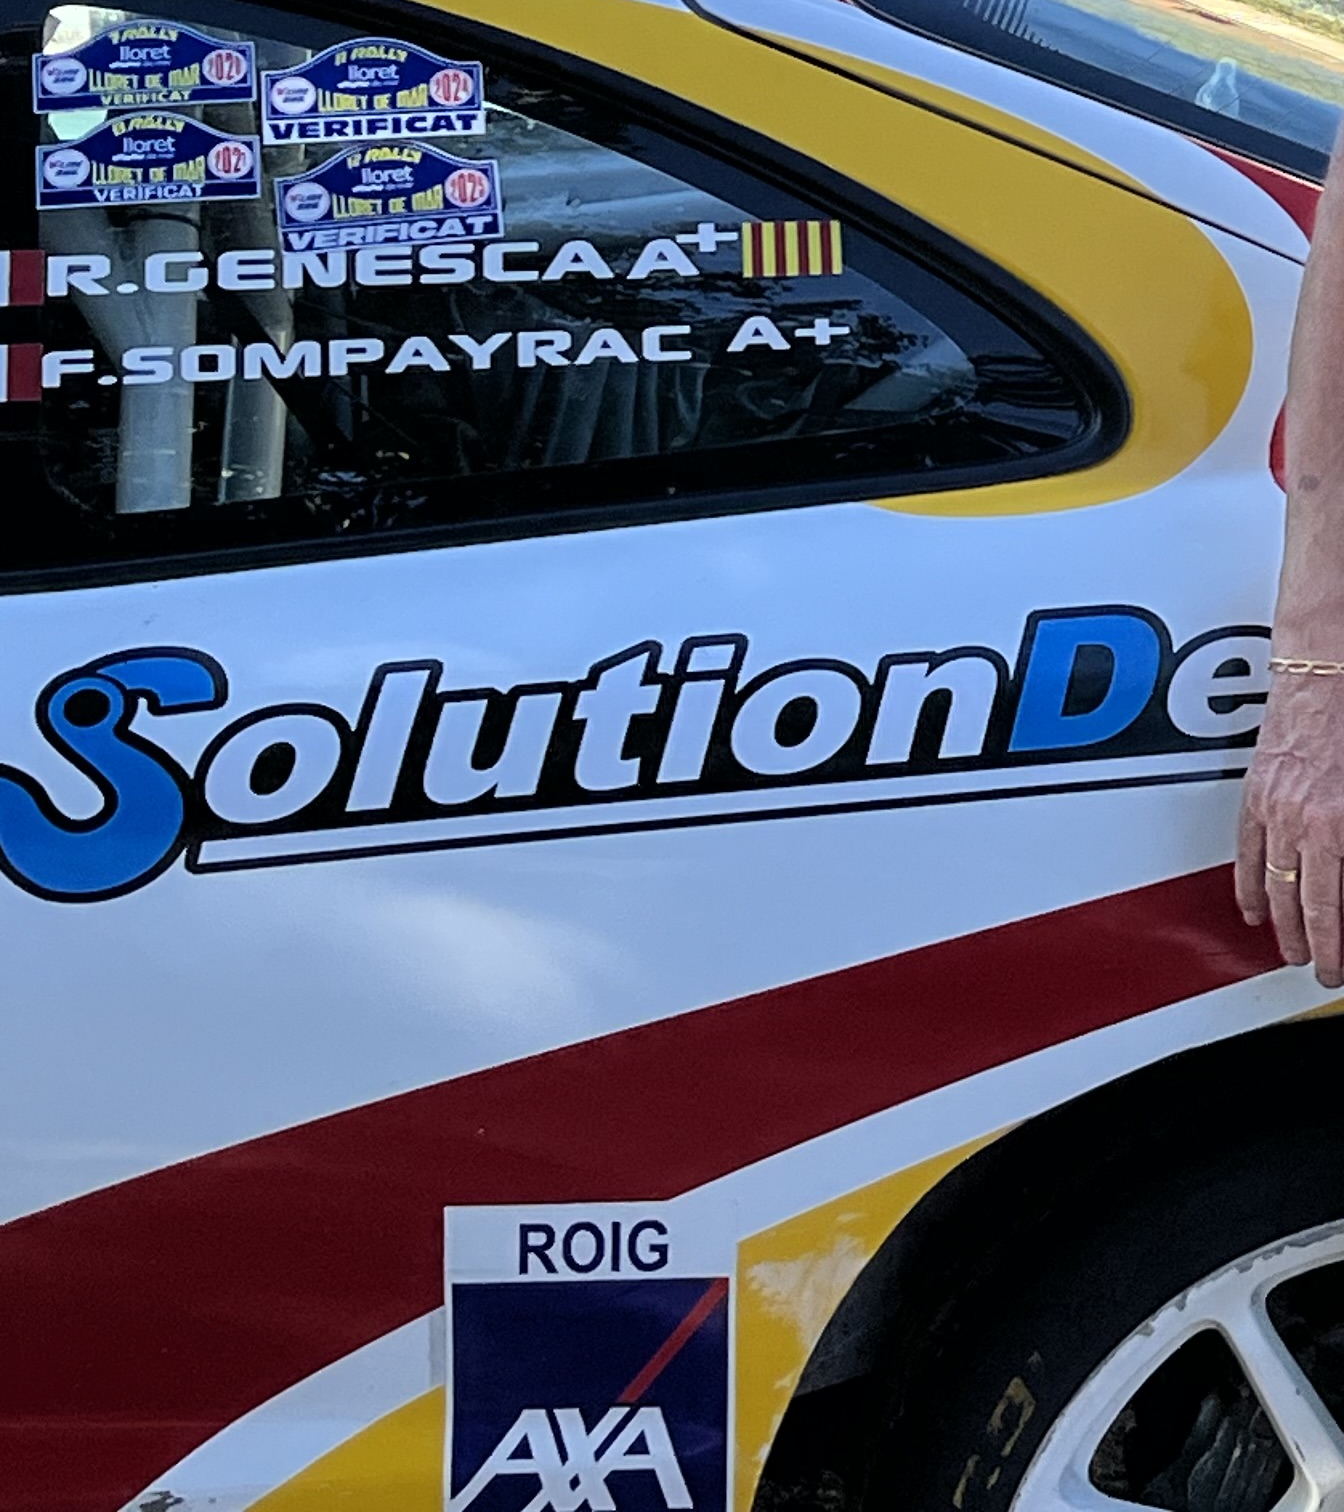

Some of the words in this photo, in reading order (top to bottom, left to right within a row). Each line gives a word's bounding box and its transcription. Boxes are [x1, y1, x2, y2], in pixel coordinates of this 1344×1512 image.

[120, 45, 172, 61] lloret
[348, 64, 400, 80] lloret
[101, 90, 193, 105] VERIFICAT
[268, 114, 479, 140] VERIFICAT
[123, 136, 176, 153] lloret
[361, 165, 414, 184] lloret
[94, 183, 204, 203] VERIFICAT
[287, 215, 493, 251] VERIFICAT
[41, 324, 693, 389] F.SOMPAYRAC
[726, 315, 851, 353] A+
[519, 1220, 669, 1275] ROIG
[450, 1406, 694, 1512] AXA
